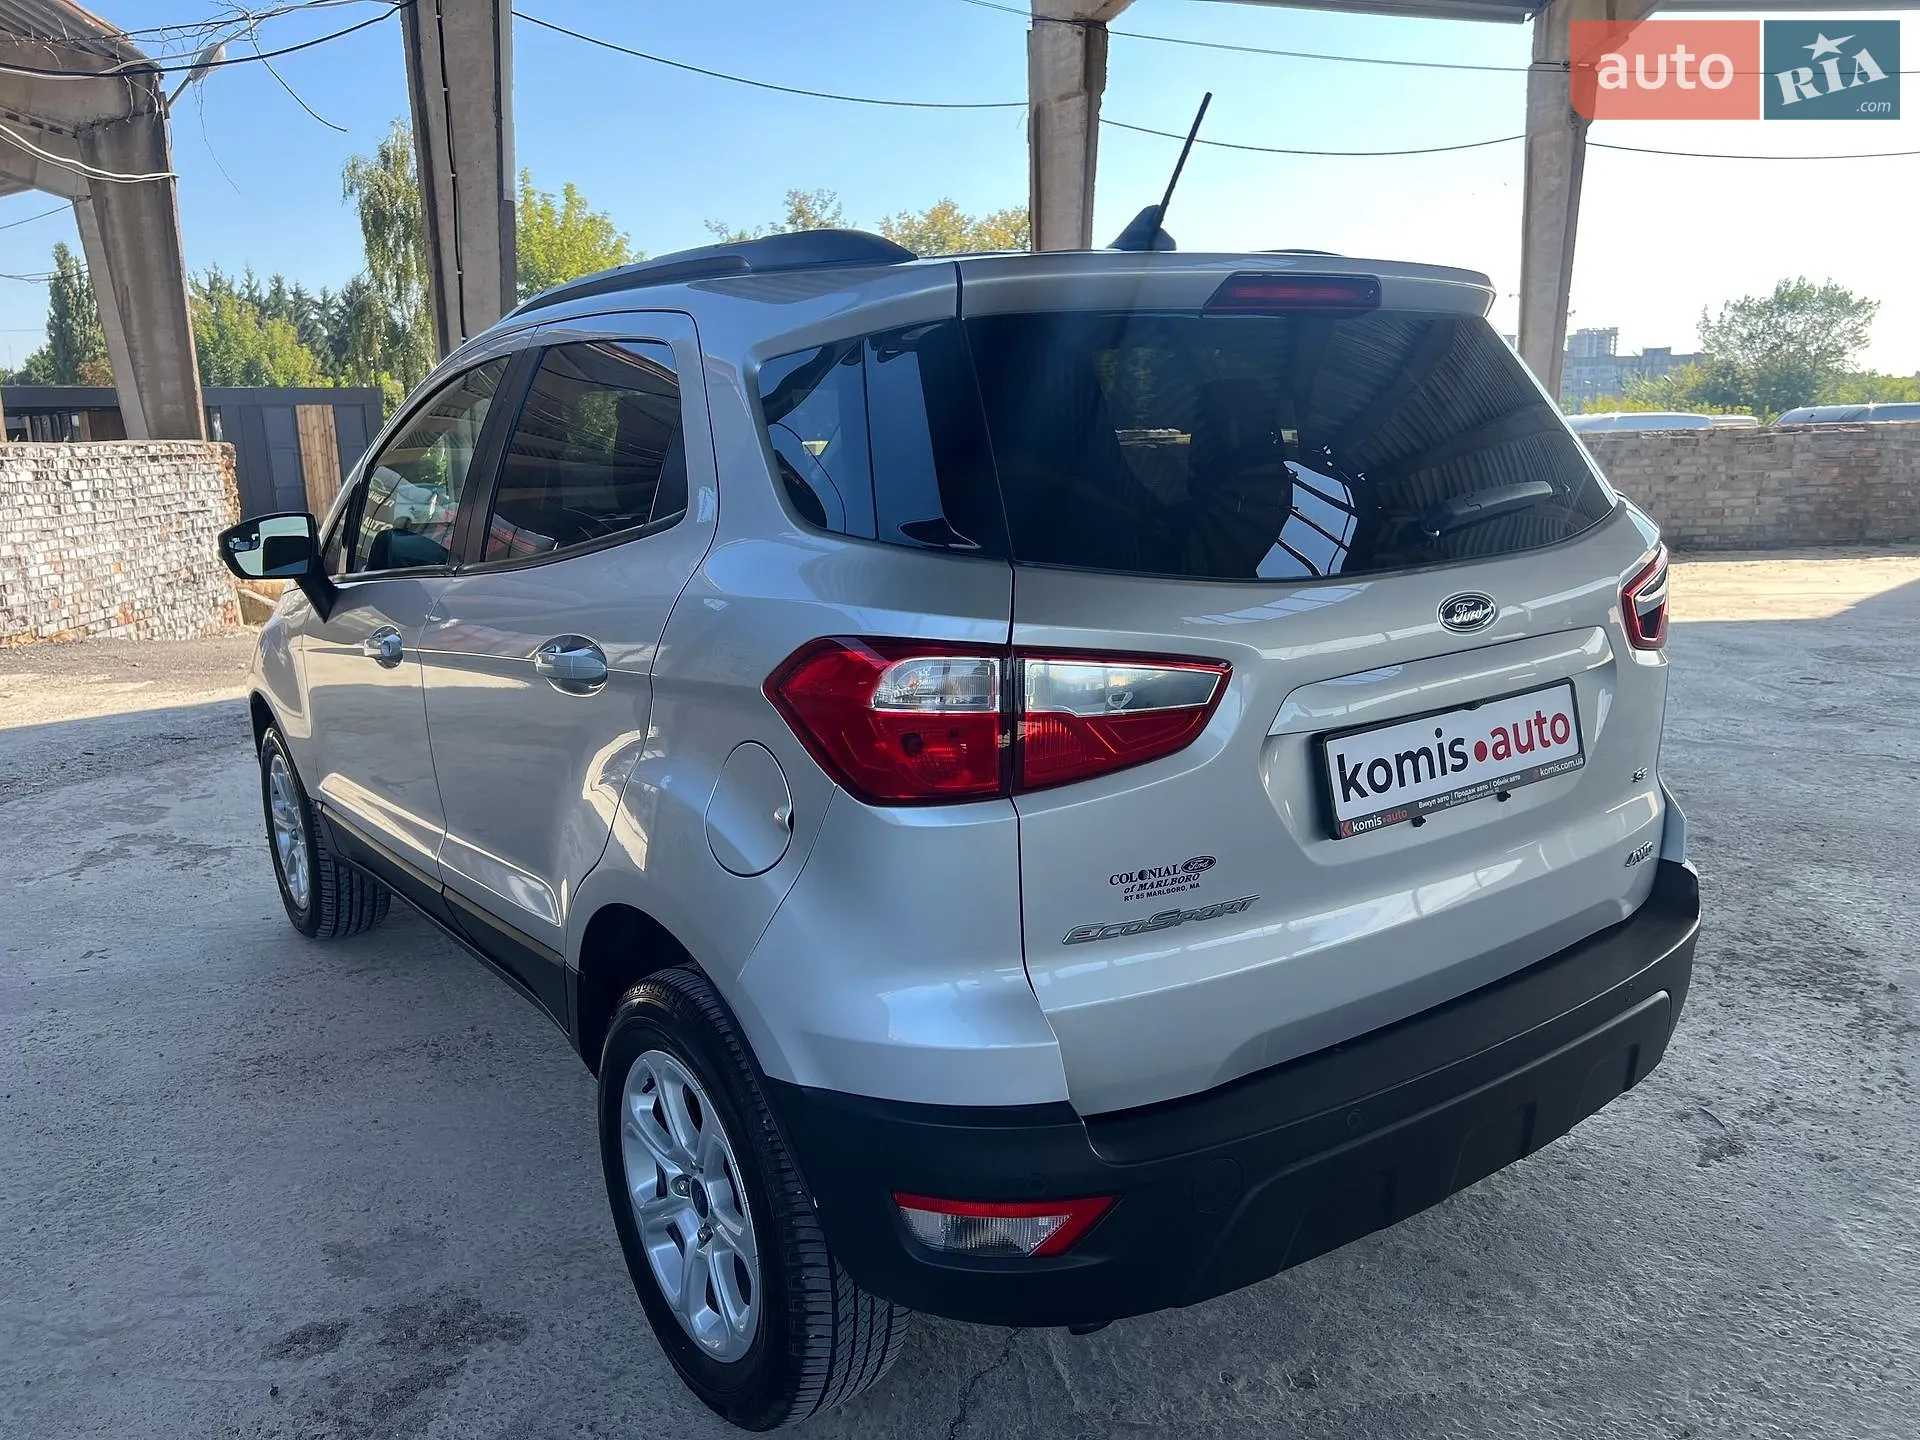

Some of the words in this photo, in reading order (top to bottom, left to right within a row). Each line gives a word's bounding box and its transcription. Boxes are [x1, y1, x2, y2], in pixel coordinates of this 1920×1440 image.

[1540, 757, 1584, 776] komis.com.ua
[1109, 864, 1180, 886] COLONIAL
[1123, 884, 1136, 894] of
[1137, 873, 1200, 892] MARLBORO
[1190, 882, 1200, 890] MA
